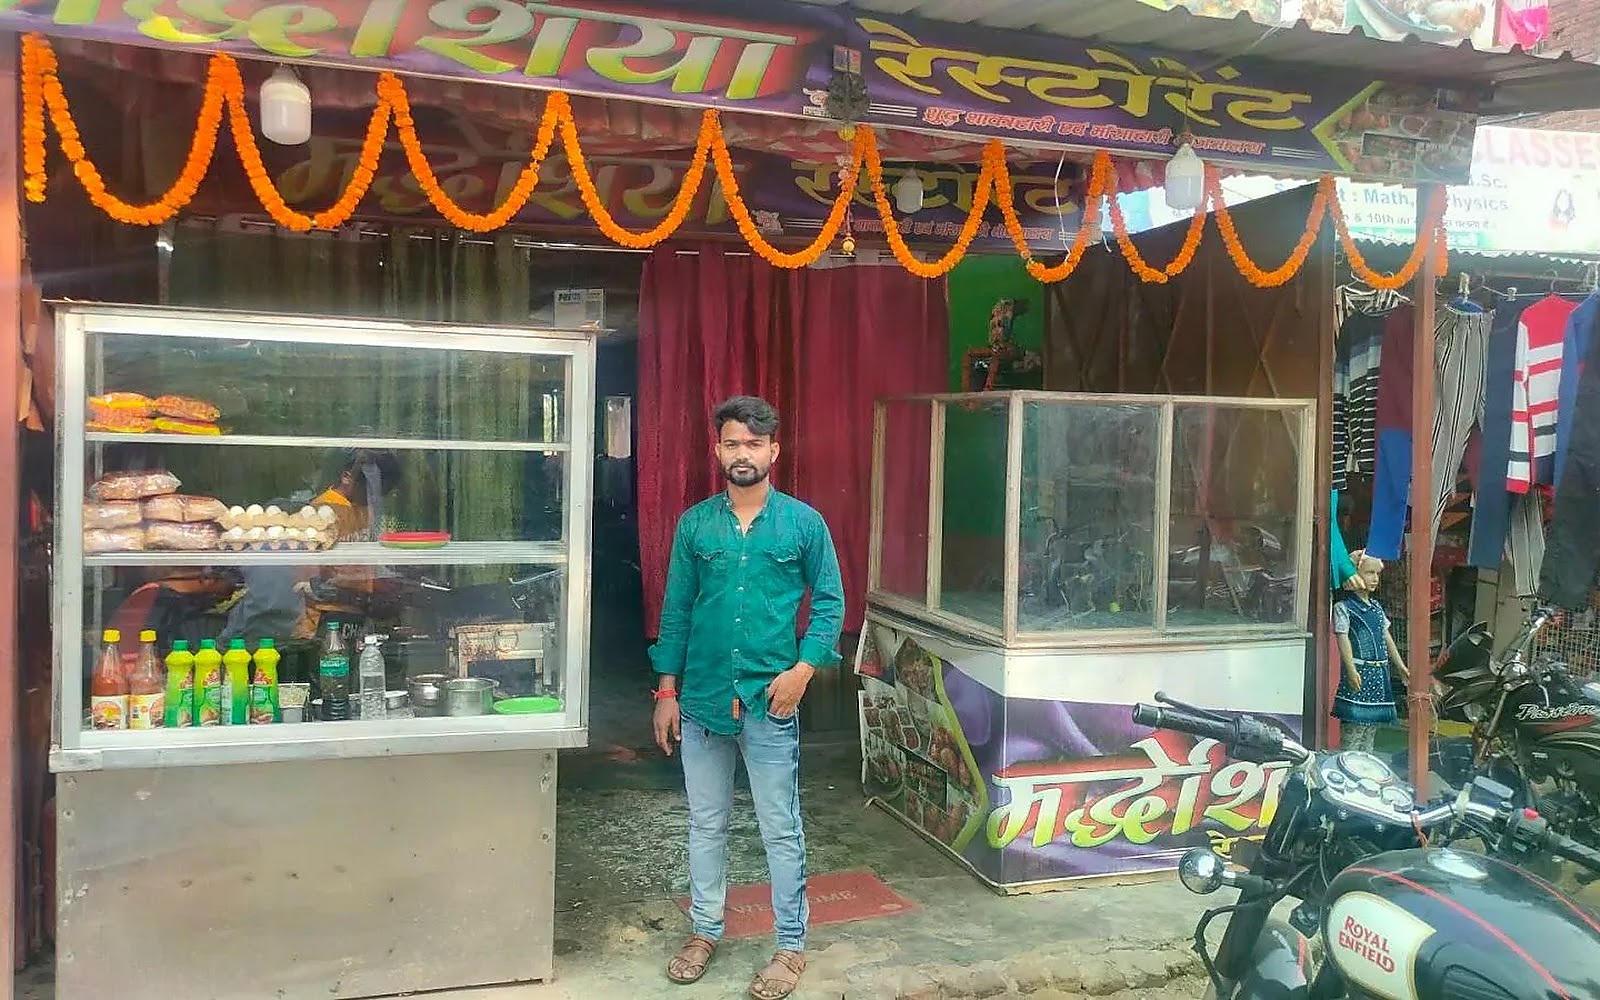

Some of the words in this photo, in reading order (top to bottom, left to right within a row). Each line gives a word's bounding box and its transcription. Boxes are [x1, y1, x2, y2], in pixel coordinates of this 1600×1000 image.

[1473, 128, 1600, 170] LASSE
[1470, 173, 1509, 189] .Sc.
[1447, 193, 1510, 212] hysics
[1338, 930, 1396, 973] ENFIELD
[1343, 915, 1390, 953] ROYAL
